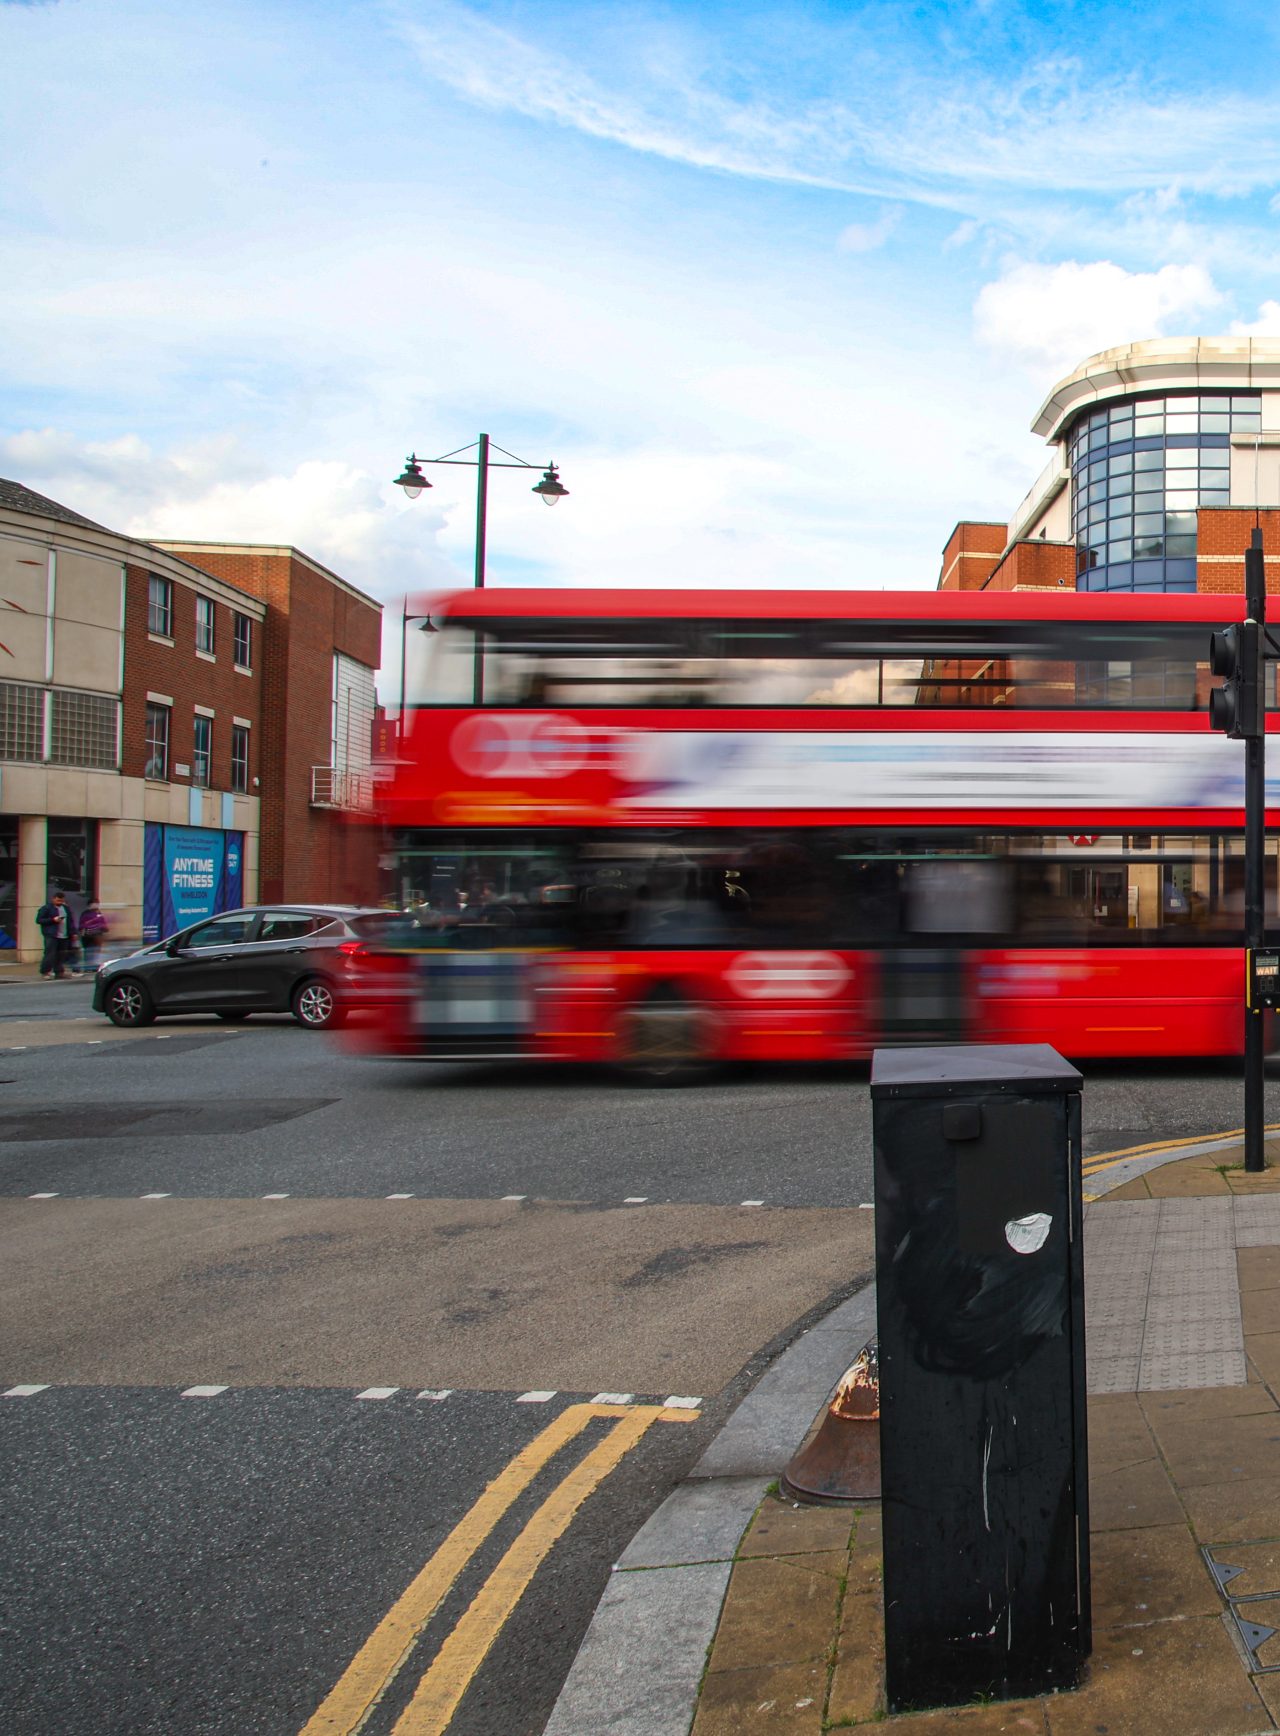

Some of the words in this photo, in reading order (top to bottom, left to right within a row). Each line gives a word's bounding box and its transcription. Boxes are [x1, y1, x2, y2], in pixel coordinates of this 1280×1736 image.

[173, 857, 213, 872] ANYTIME
[173, 874, 213, 888] FITNESS
[1257, 966, 1278, 975] WAIT
